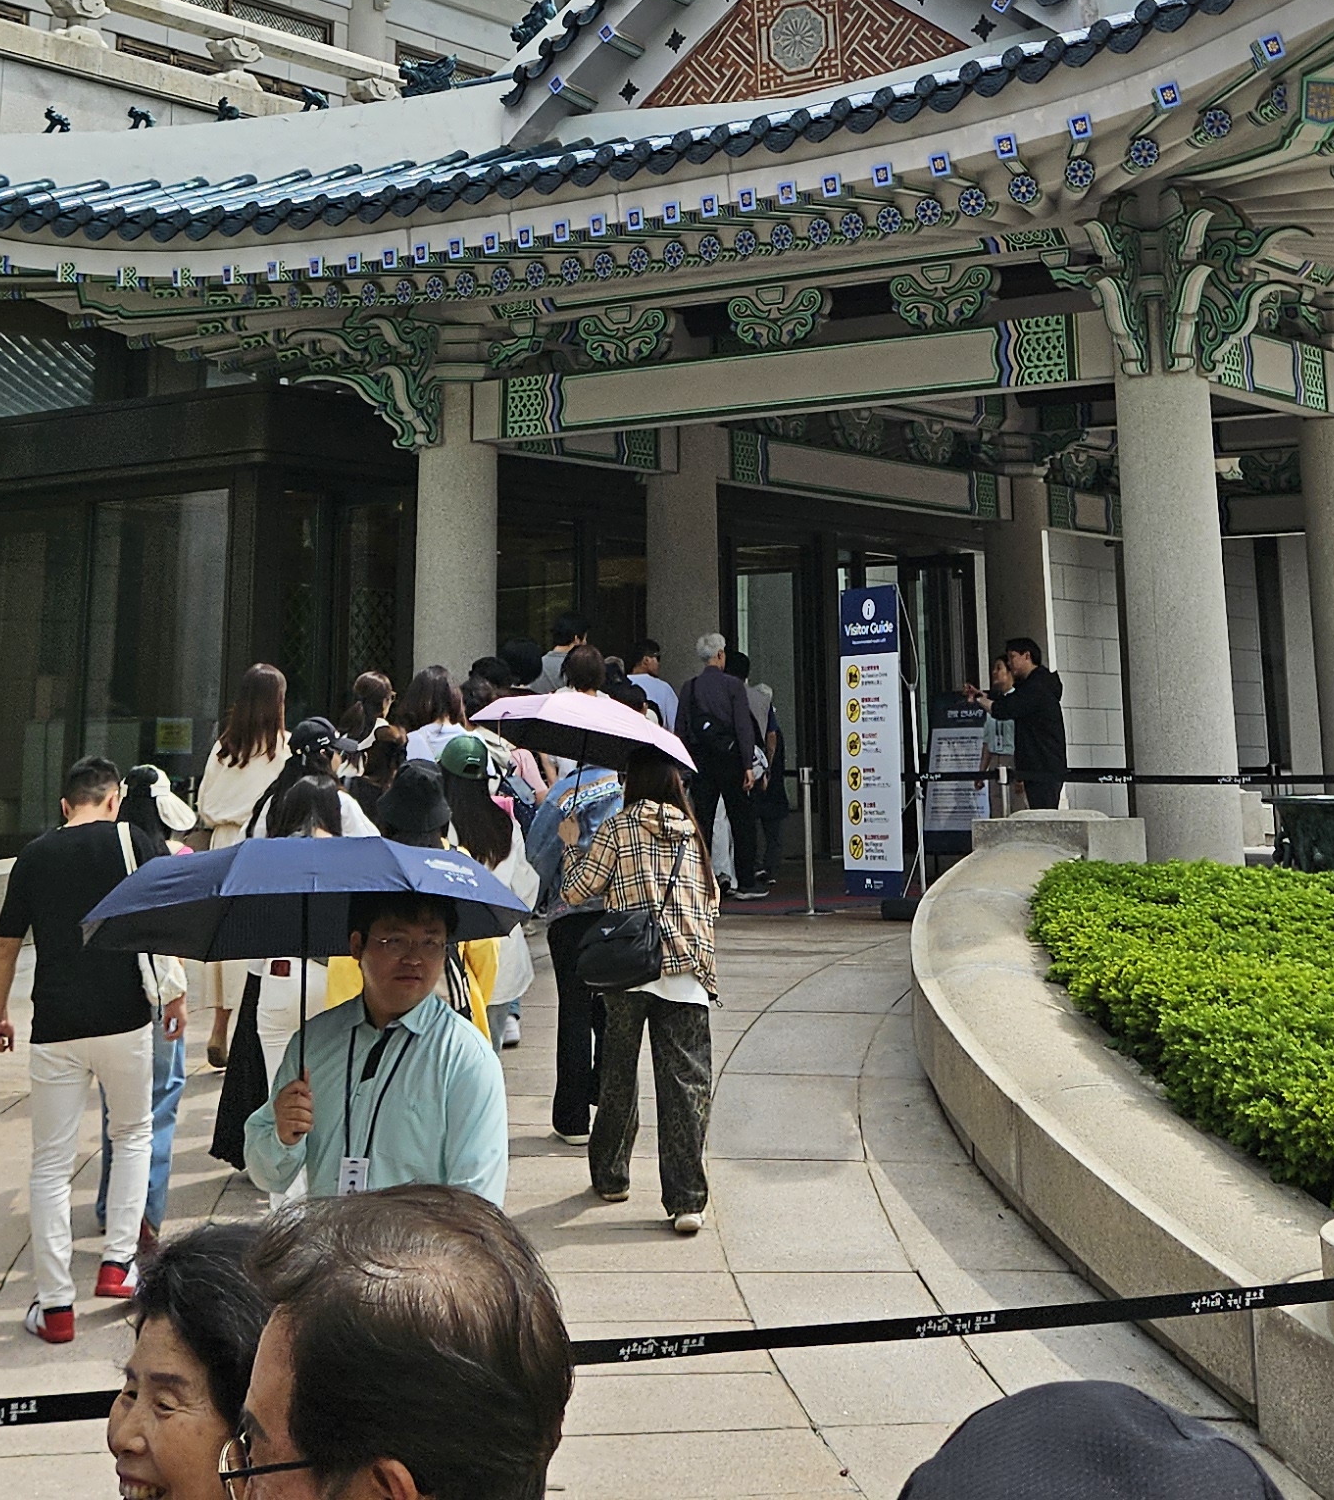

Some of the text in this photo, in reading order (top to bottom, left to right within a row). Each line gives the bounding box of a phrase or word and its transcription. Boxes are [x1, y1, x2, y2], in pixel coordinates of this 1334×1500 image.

[844, 620, 894, 637] Visitor Guide
[1227, 1293, 1242, 1309] 국민
[954, 1318, 971, 1334] 국민
[661, 1340, 679, 1356] 국민
[9, 1399, 38, 1422] 품으로
